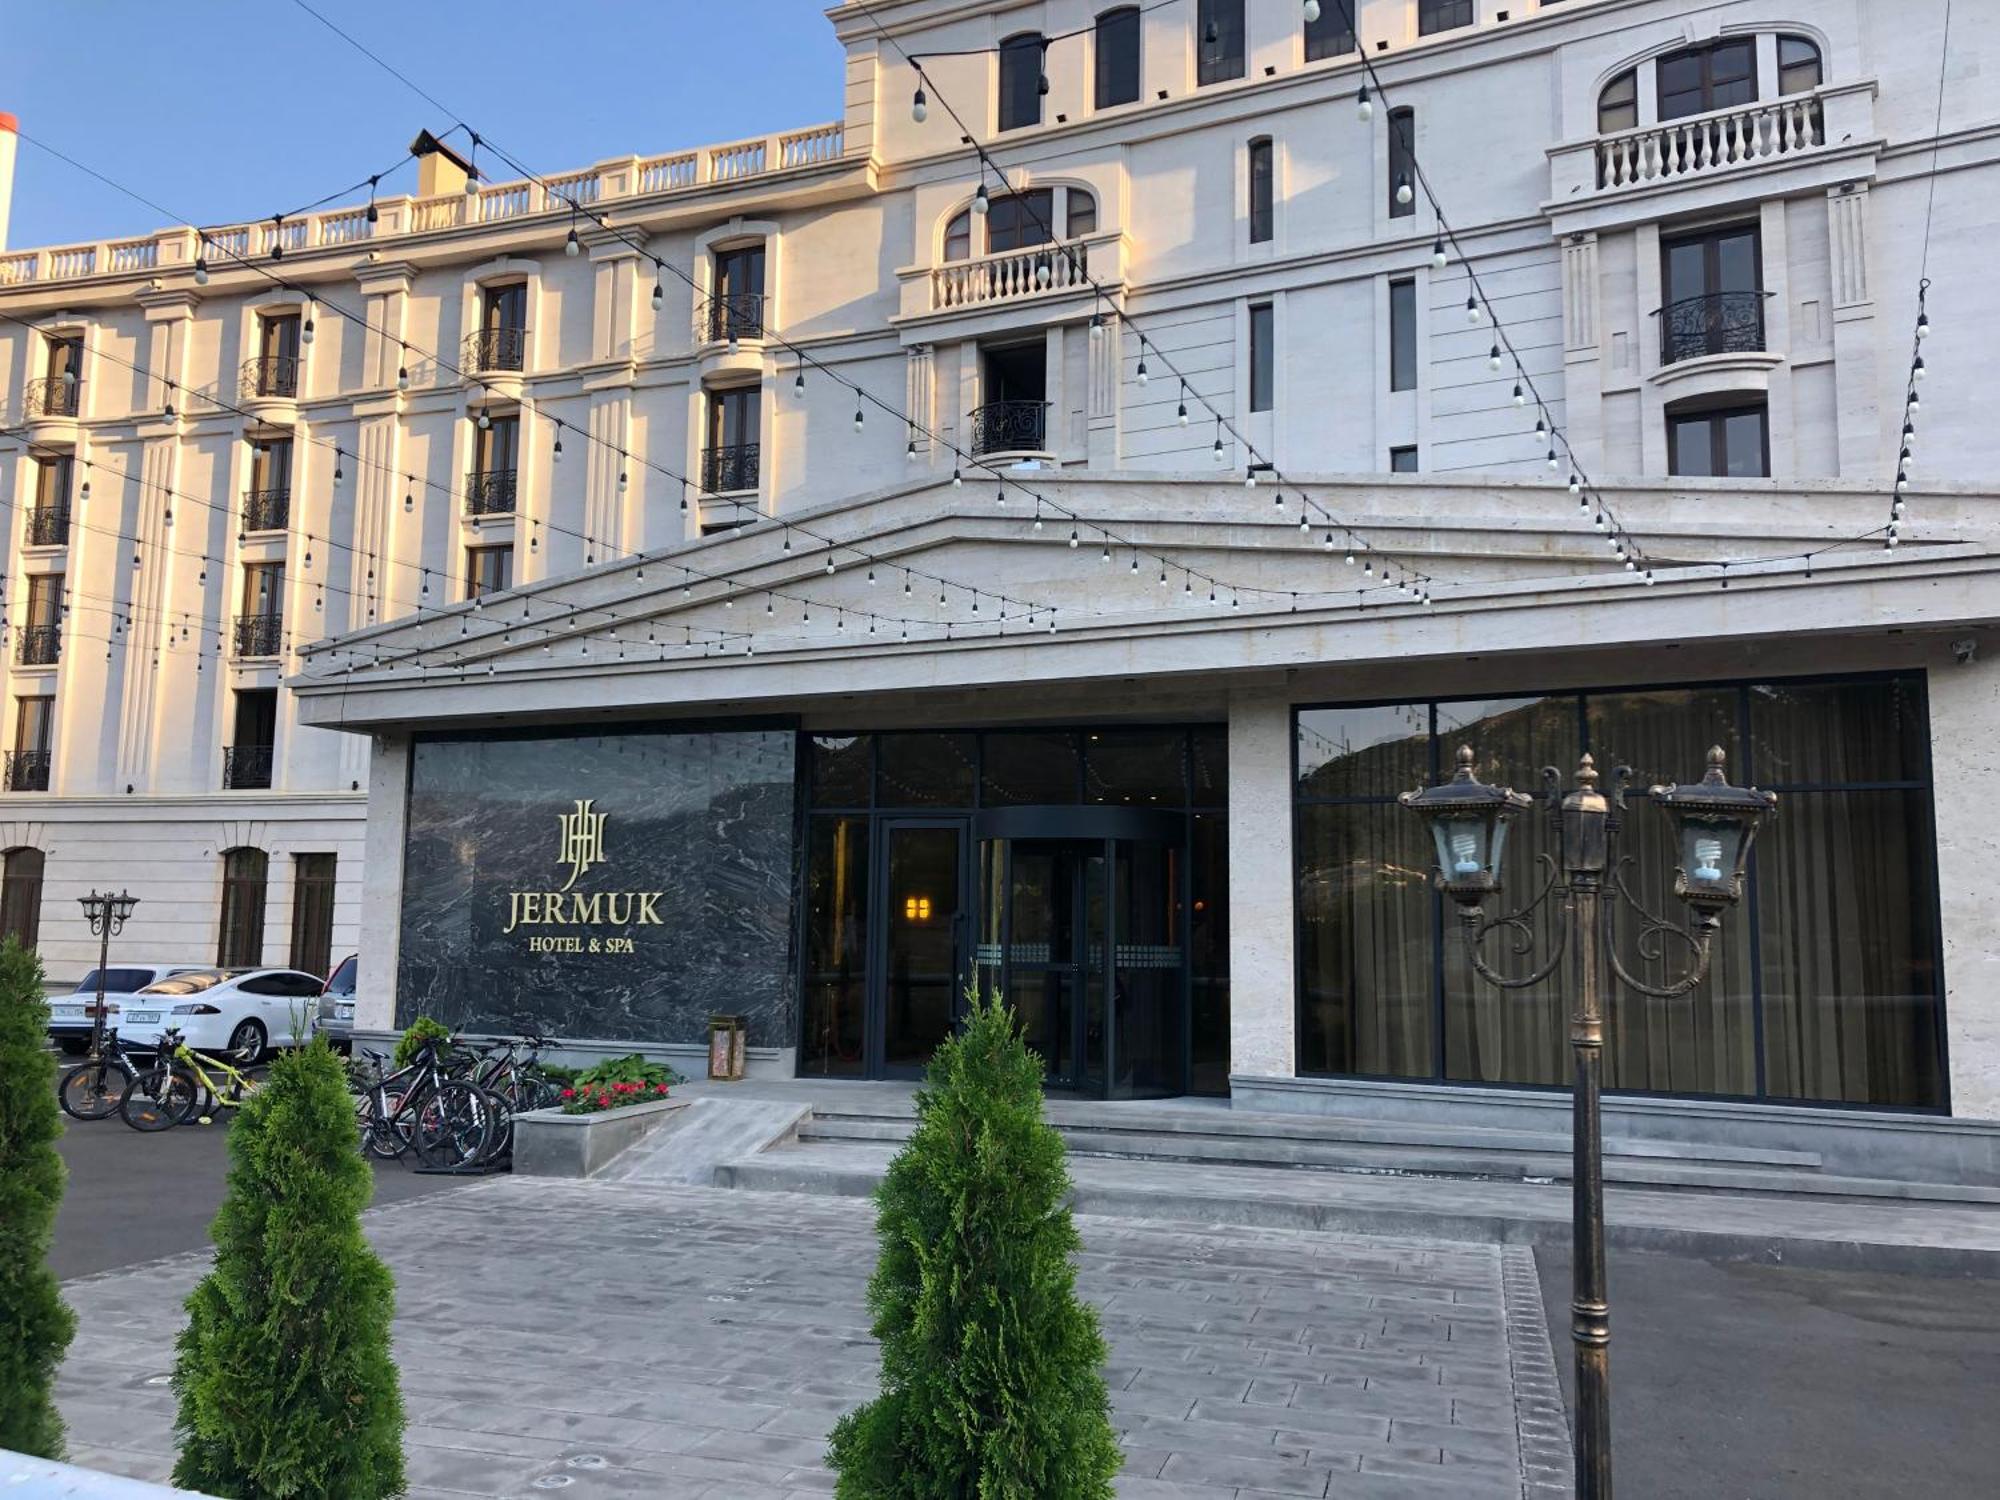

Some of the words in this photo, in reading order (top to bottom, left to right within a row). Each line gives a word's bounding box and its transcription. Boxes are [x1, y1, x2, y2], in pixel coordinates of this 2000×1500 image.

[503, 892, 665, 934] JERMUK
[529, 936, 584, 953] HOTEL
[588, 937, 601, 953] &
[605, 937, 635, 953] SPA
